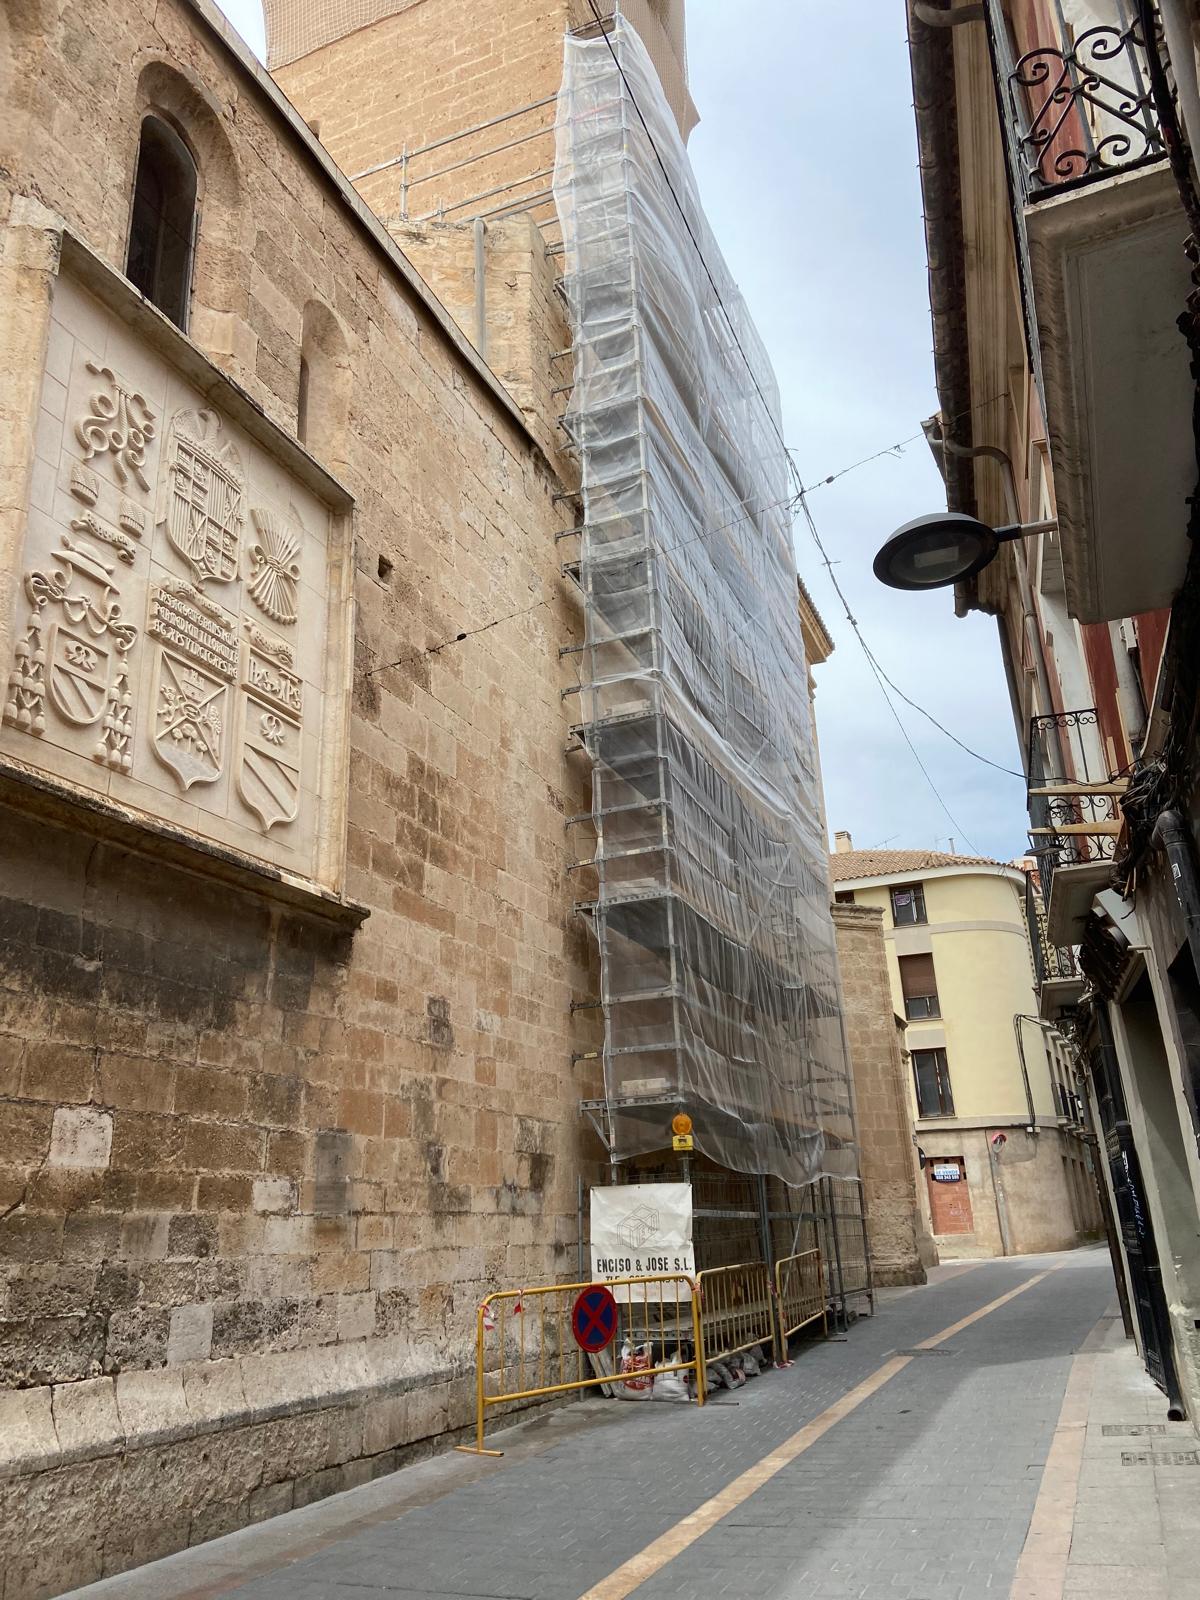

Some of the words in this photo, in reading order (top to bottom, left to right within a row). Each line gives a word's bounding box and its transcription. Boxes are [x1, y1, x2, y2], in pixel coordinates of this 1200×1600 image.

[597, 1258, 631, 1273] ENCISO
[636, 1259, 643, 1272] &
[646, 1256, 669, 1271] JOSE
[674, 1257, 692, 1271] S.L.
